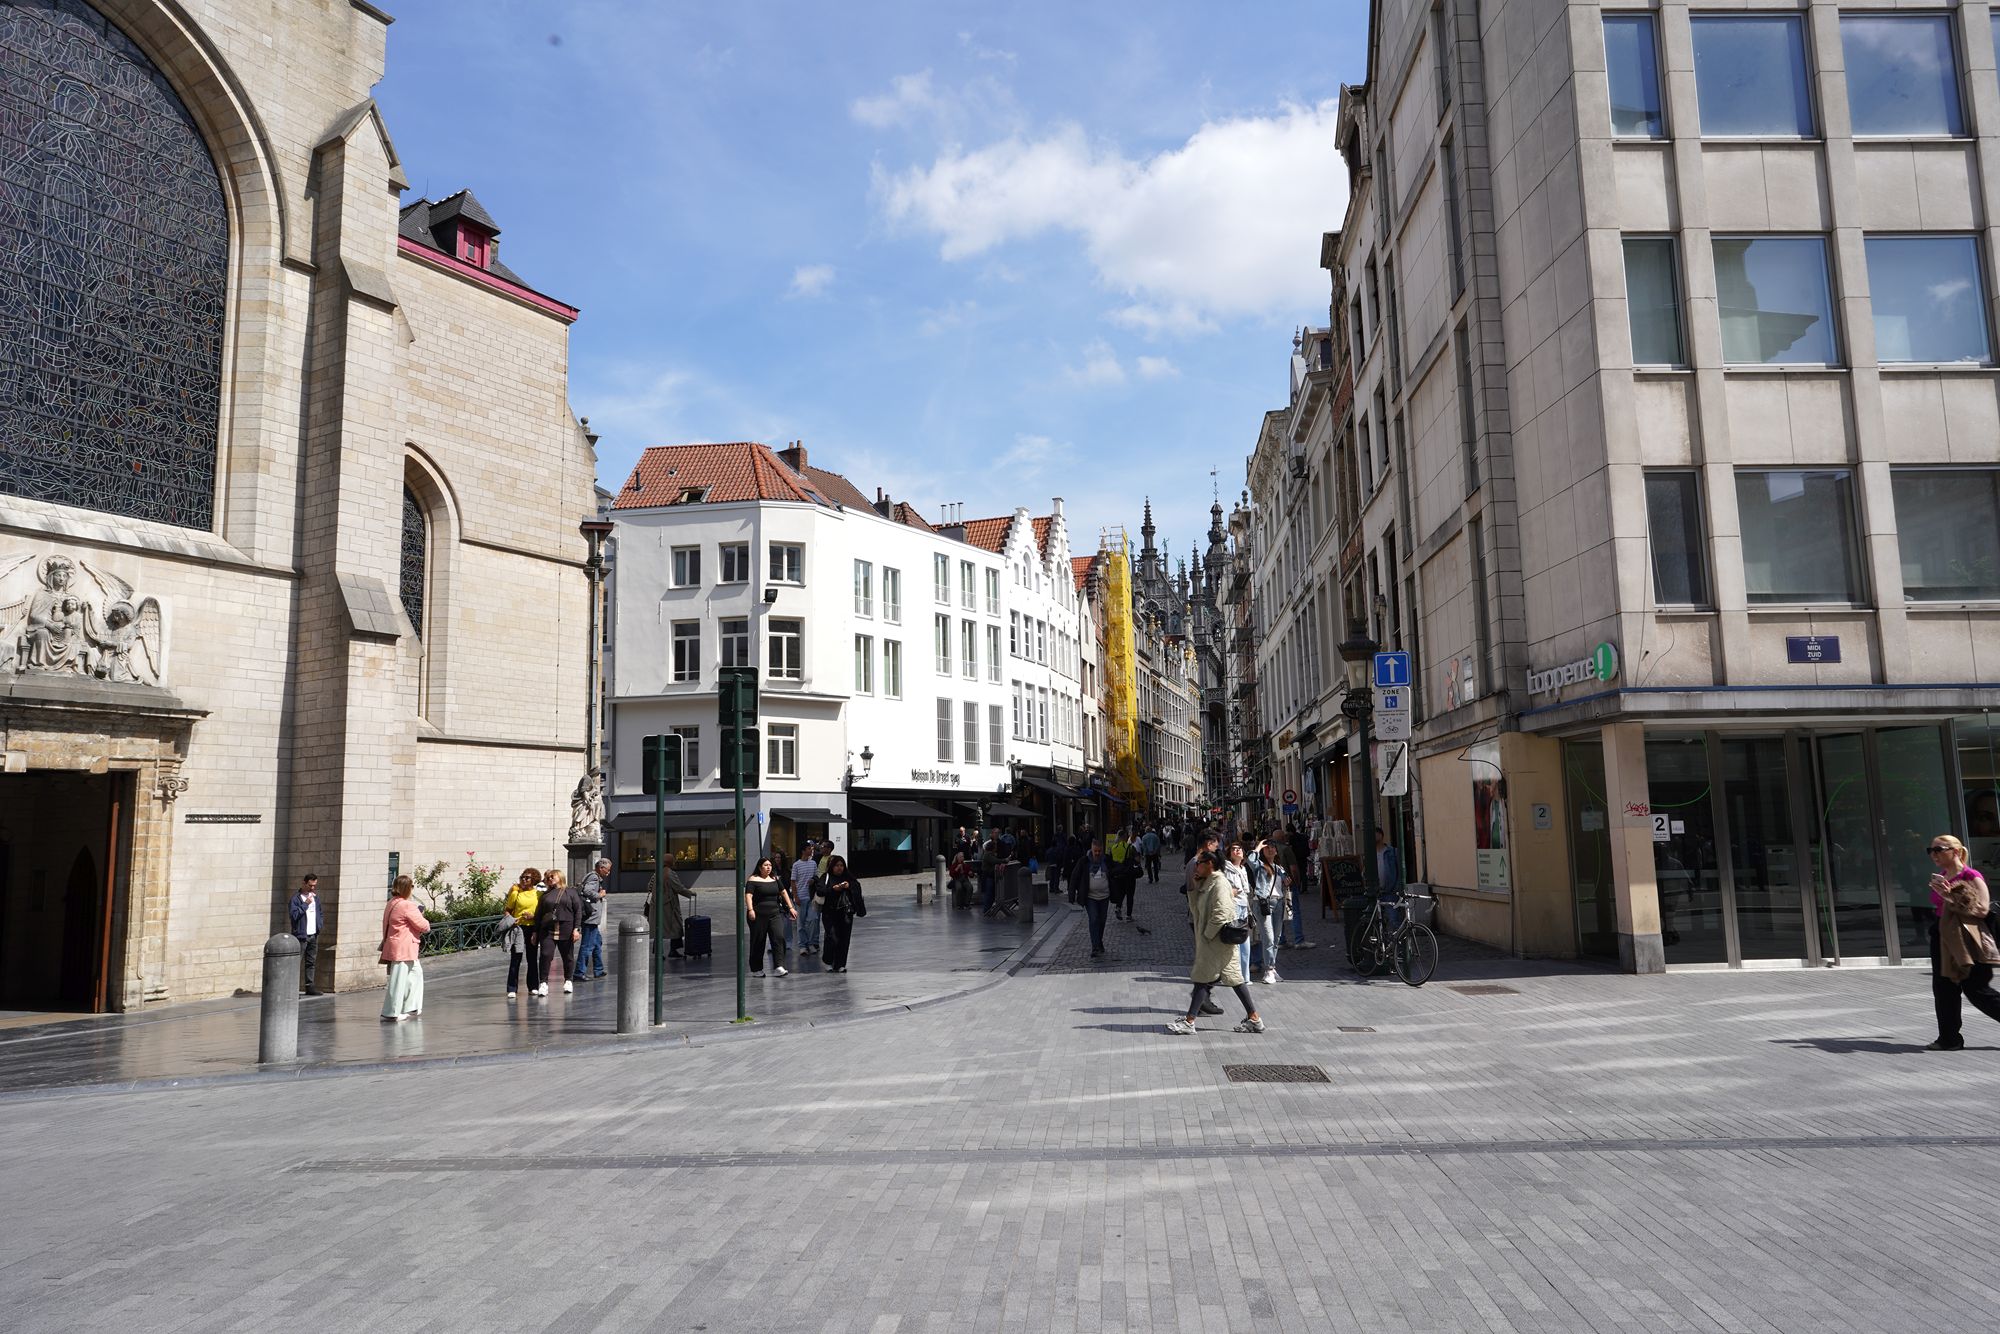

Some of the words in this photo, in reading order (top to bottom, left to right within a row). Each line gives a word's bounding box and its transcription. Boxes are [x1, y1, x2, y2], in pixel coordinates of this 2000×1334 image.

[911, 768, 929, 782] Maison
[929, 769, 936, 782] De
[1538, 807, 1546, 818] 2
[1655, 817, 1665, 832] 2
